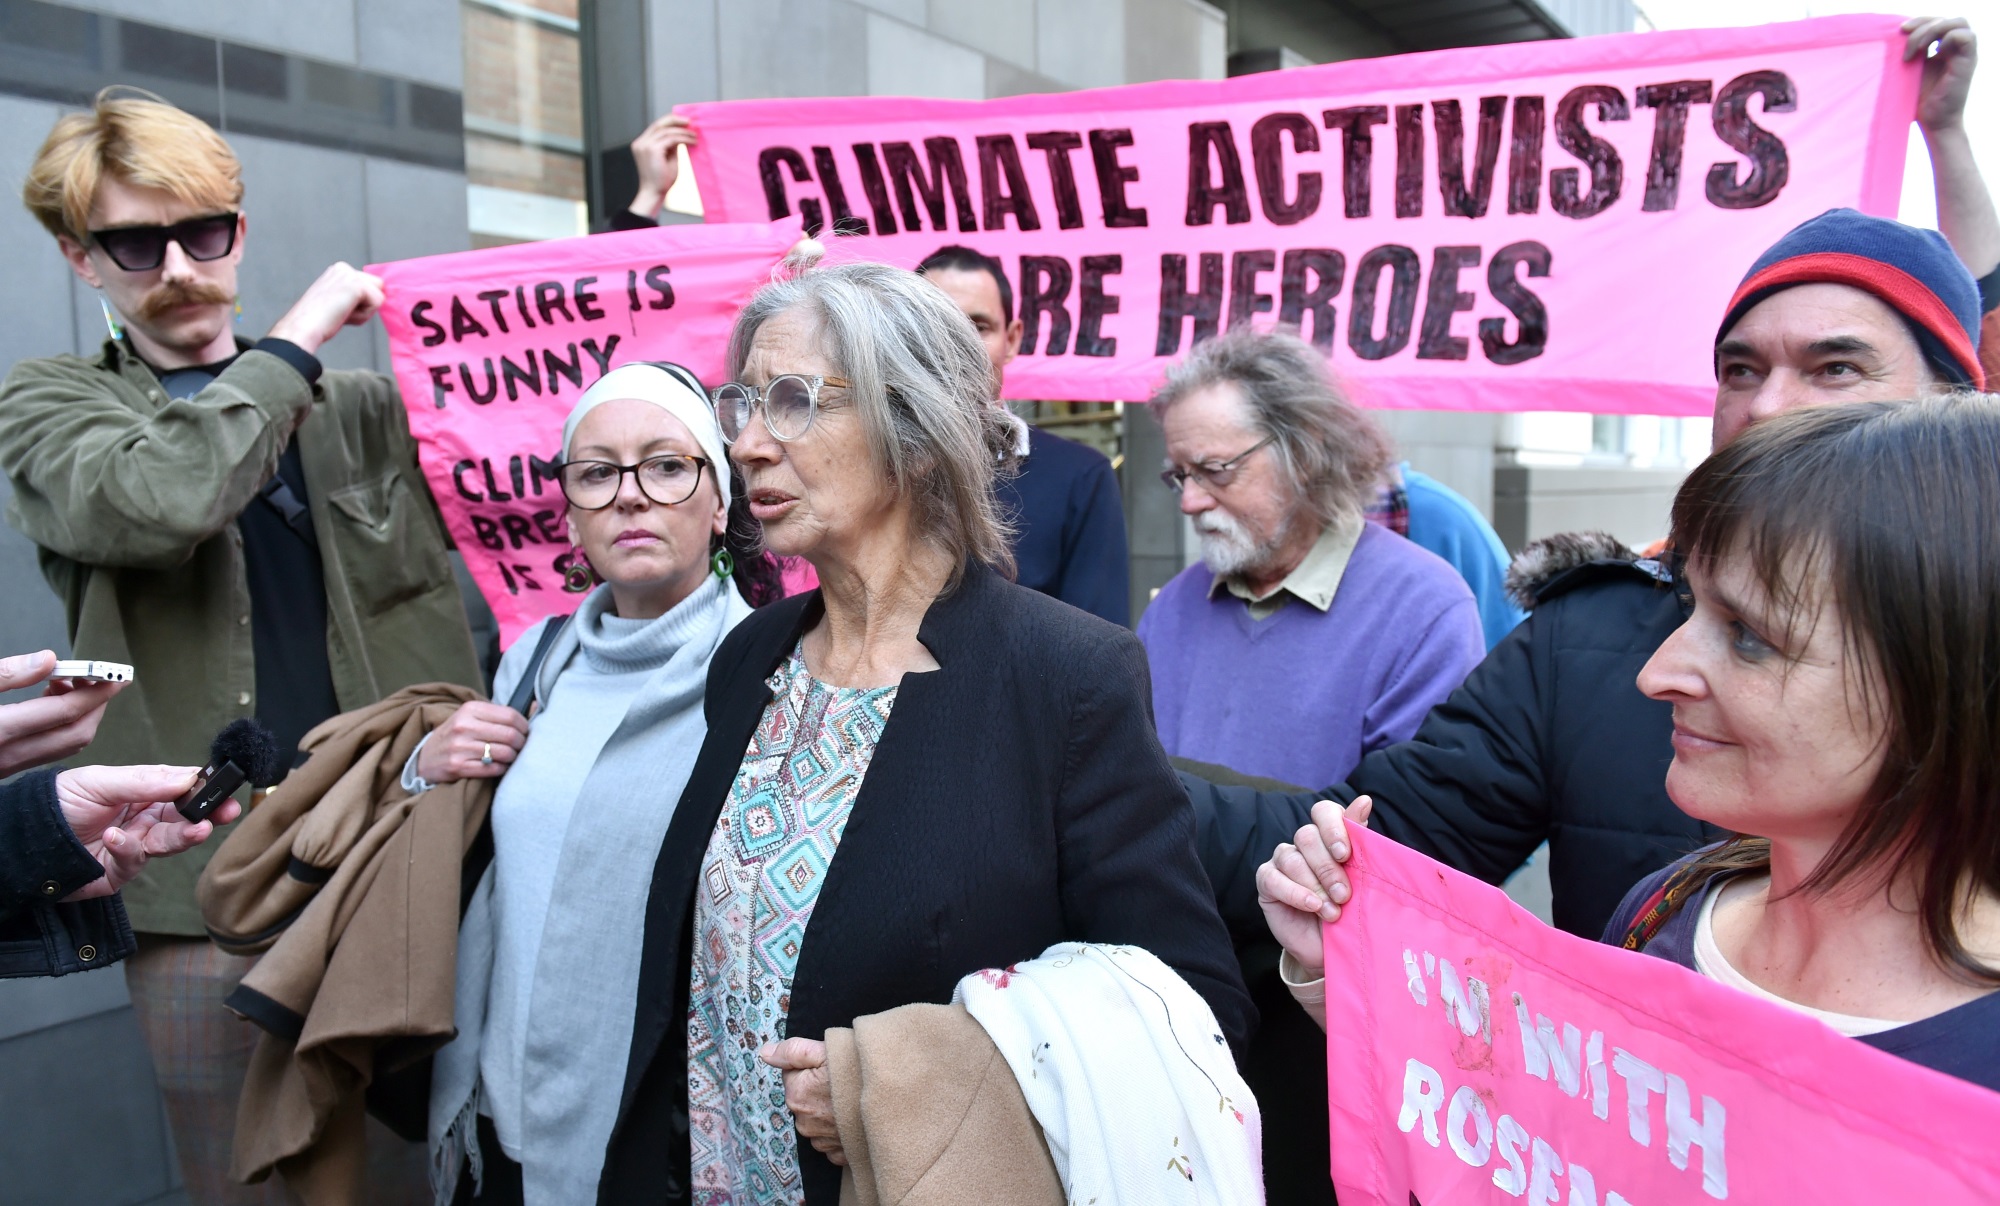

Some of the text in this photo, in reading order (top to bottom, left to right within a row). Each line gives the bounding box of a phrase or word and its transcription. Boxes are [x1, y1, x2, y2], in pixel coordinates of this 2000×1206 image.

[758, 69, 1797, 238] CLIMATE ACTIVISTS
[411, 265, 676, 347] SATIRE IS
[988, 240, 1552, 365] RE HEROES
[429, 334, 621, 409] FUNNY
[498, 560, 543, 595] IS
[1511, 991, 1728, 1201] WITH
